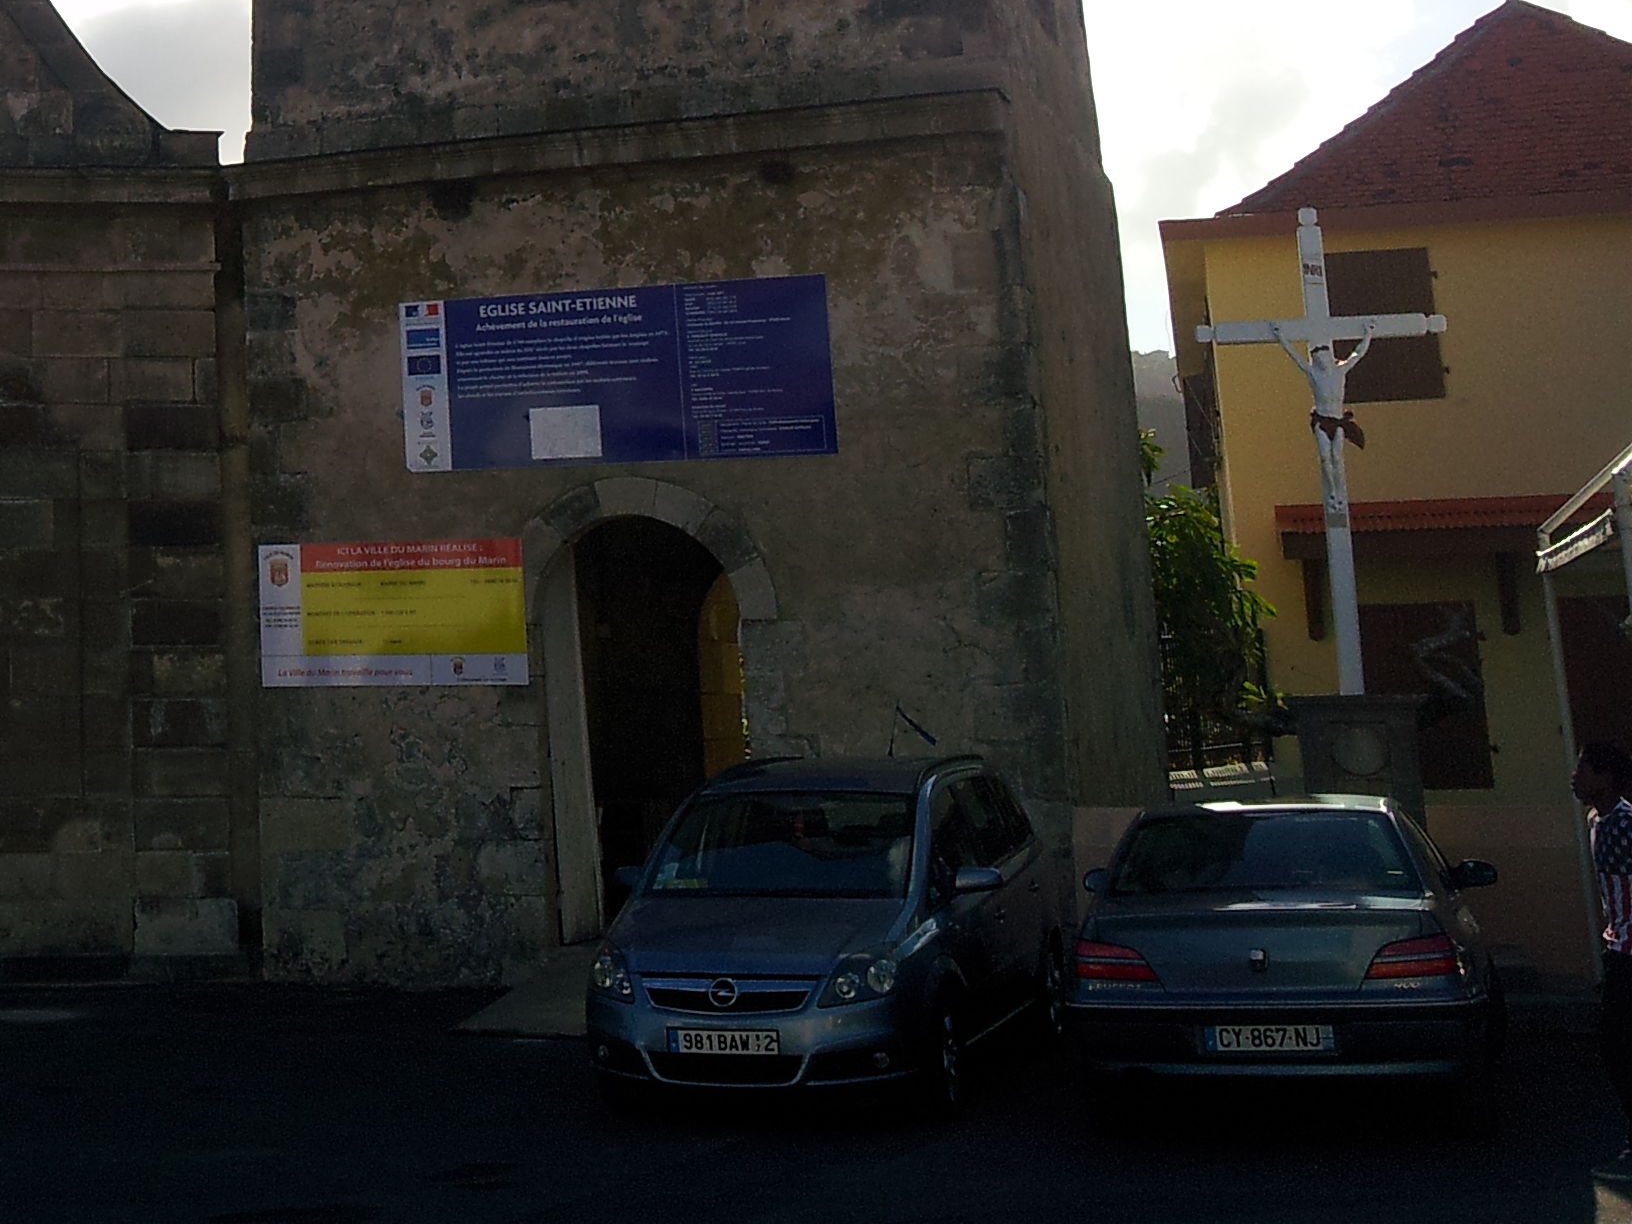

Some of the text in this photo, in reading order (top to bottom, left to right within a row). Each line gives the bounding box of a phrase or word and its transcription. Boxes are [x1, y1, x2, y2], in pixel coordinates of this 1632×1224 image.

[479, 295, 637, 318] EGLISE SAINT-ETIENNE
[527, 319, 538, 329] de
[539, 318, 548, 328] la
[601, 314, 612, 324] de
[337, 547, 349, 556] ICI
[350, 547, 362, 555] LA
[362, 545, 389, 554] VILLE
[390, 545, 405, 554] DU
[406, 544, 438, 553] MARIN
[369, 558, 382, 567] de
[417, 557, 430, 566] du
[432, 556, 461, 567] bourg
[463, 556, 477, 565] du
[478, 556, 507, 565] Marin
